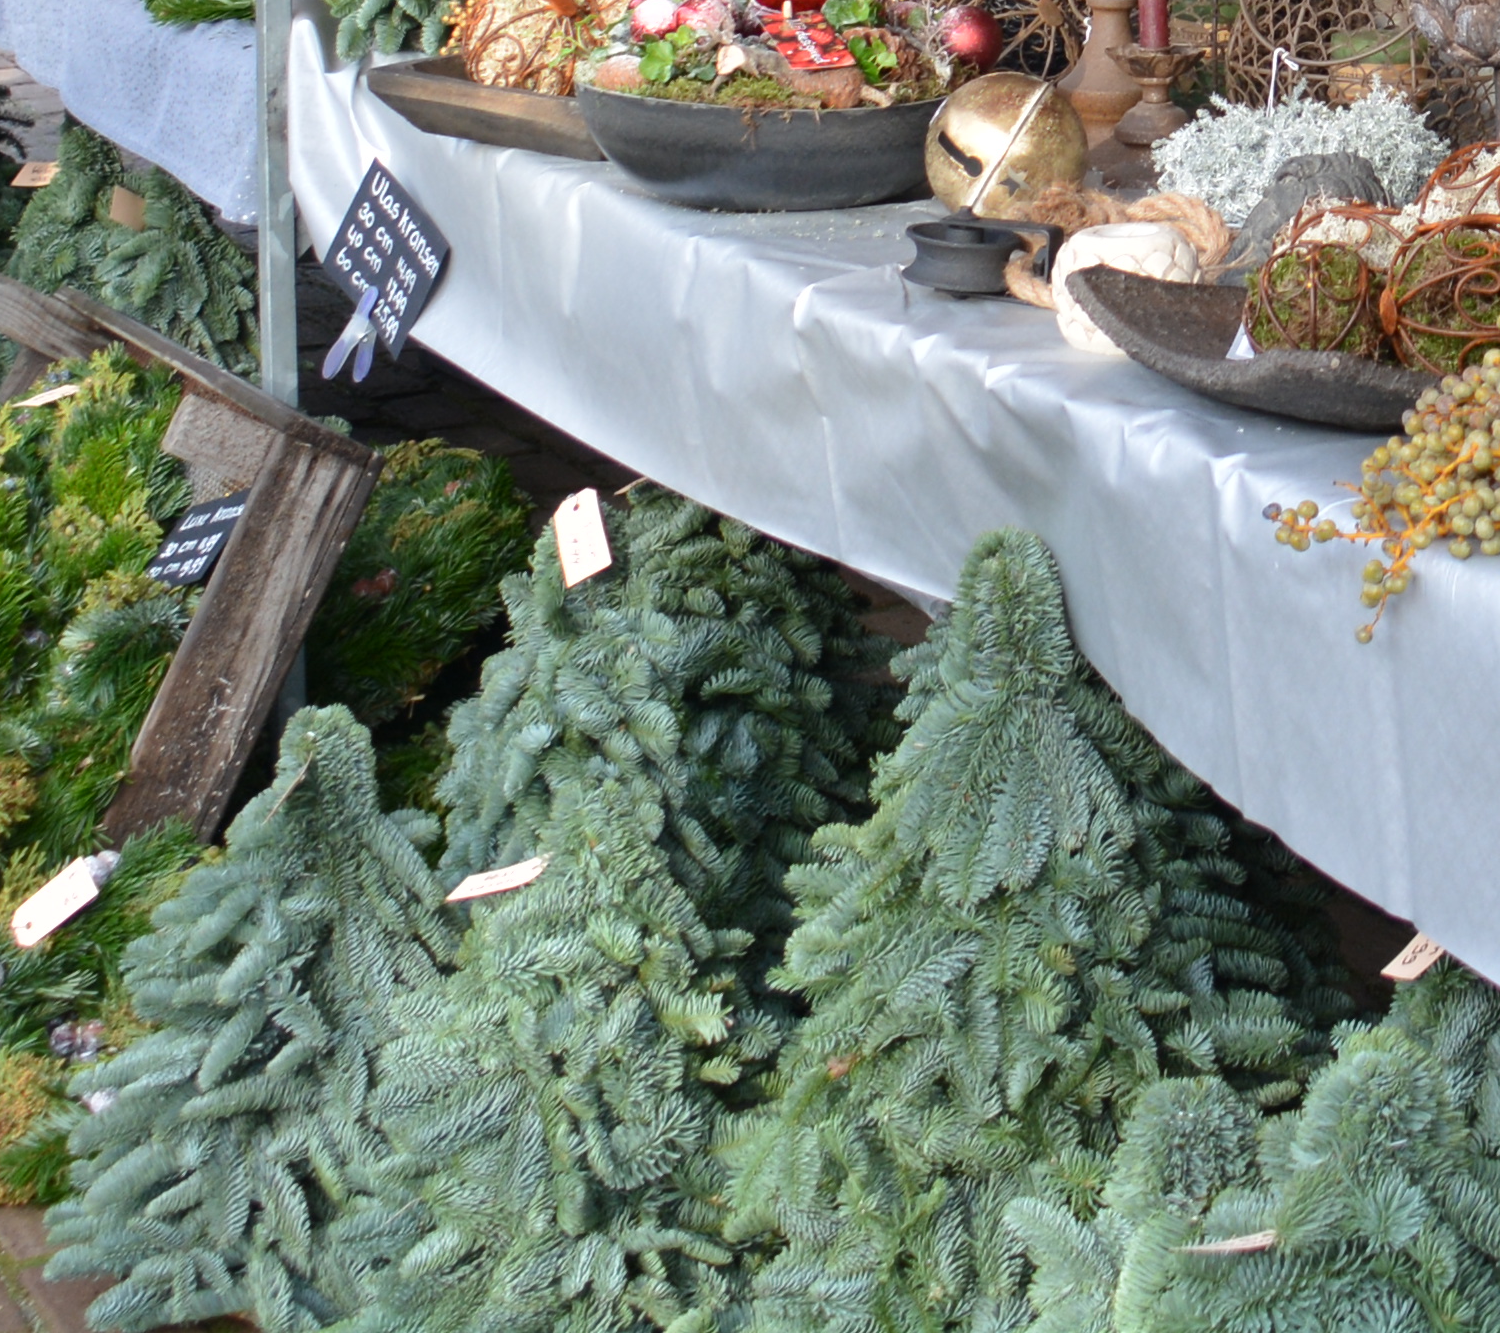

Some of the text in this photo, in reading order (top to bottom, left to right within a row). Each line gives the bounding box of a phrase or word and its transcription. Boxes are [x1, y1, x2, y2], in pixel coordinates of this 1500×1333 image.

[347, 223, 363, 248] 40
[364, 246, 382, 273] cm
[358, 202, 375, 228] 30
[376, 226, 393, 255] cm
